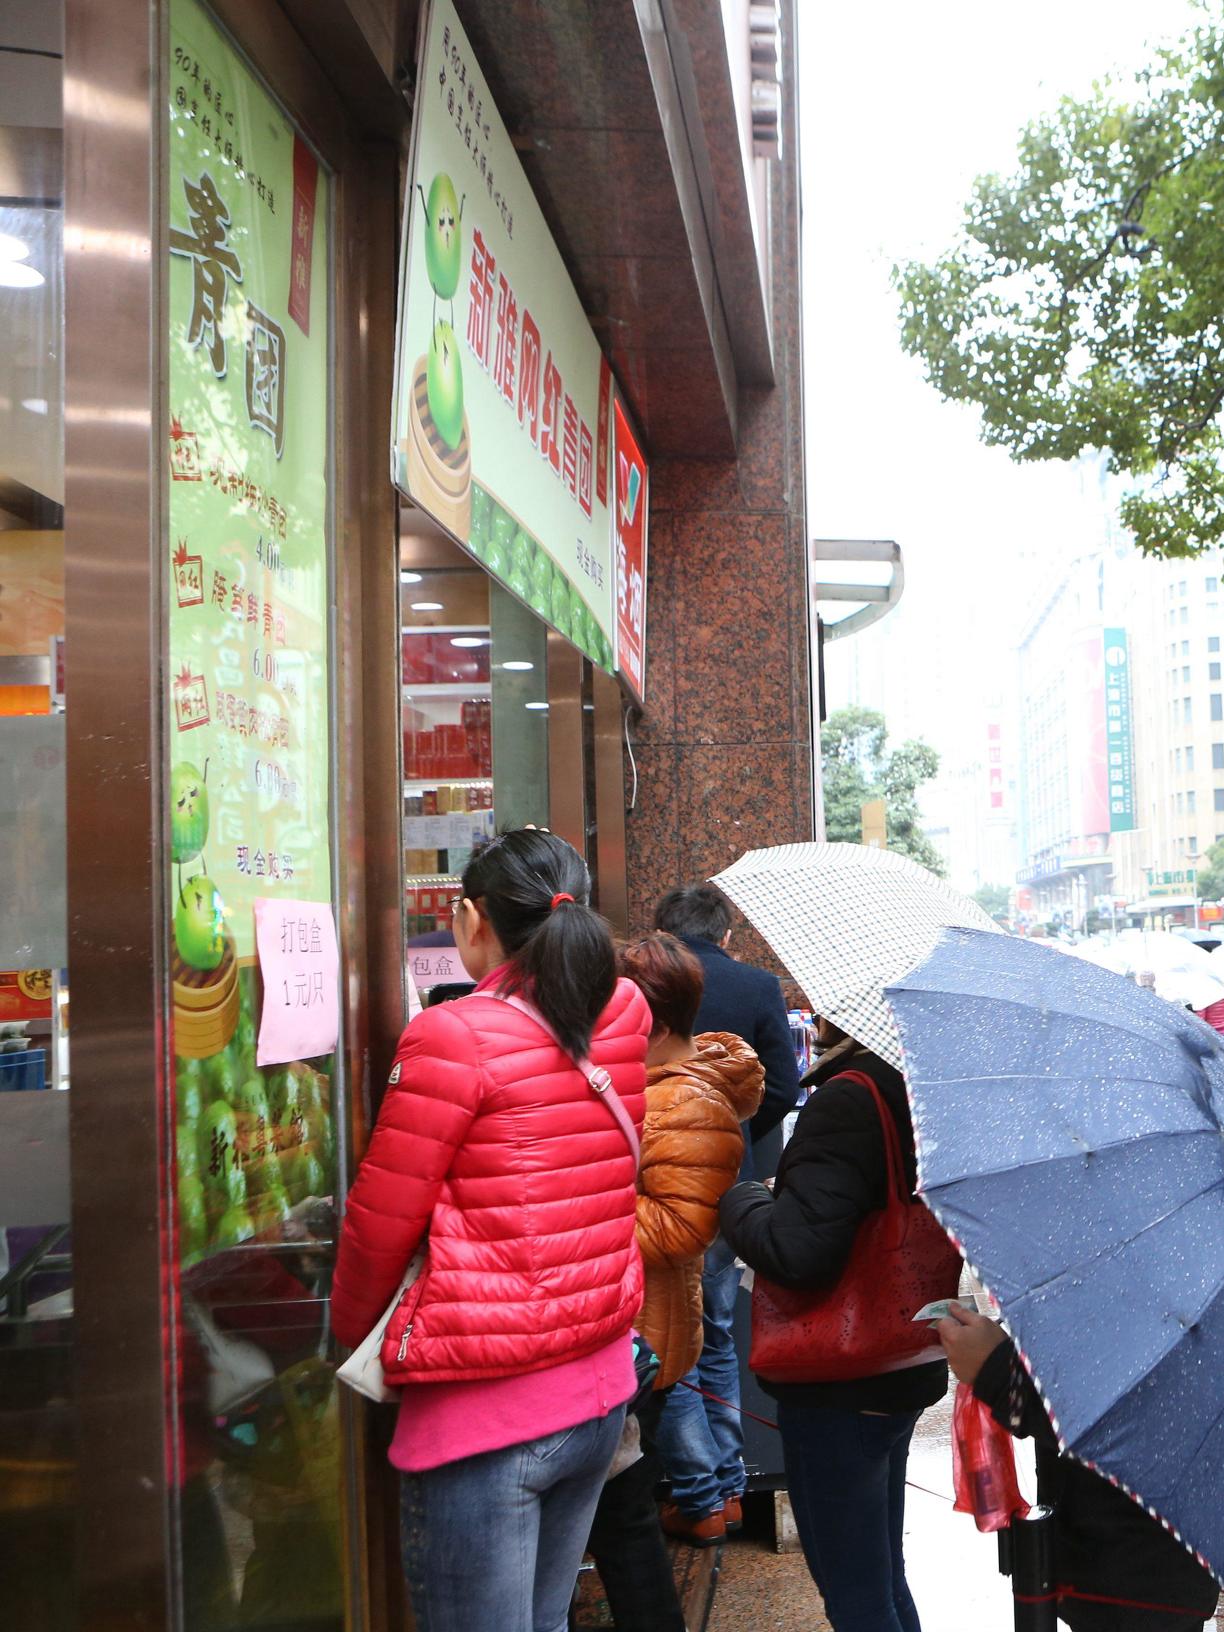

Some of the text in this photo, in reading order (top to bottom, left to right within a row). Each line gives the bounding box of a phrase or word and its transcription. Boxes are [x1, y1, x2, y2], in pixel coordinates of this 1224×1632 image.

[466, 226, 594, 523] 新雅网红青团
[236, 845, 294, 880] 现金购买
[280, 917, 323, 954] 打包盒
[412, 955, 454, 977] 包盒
